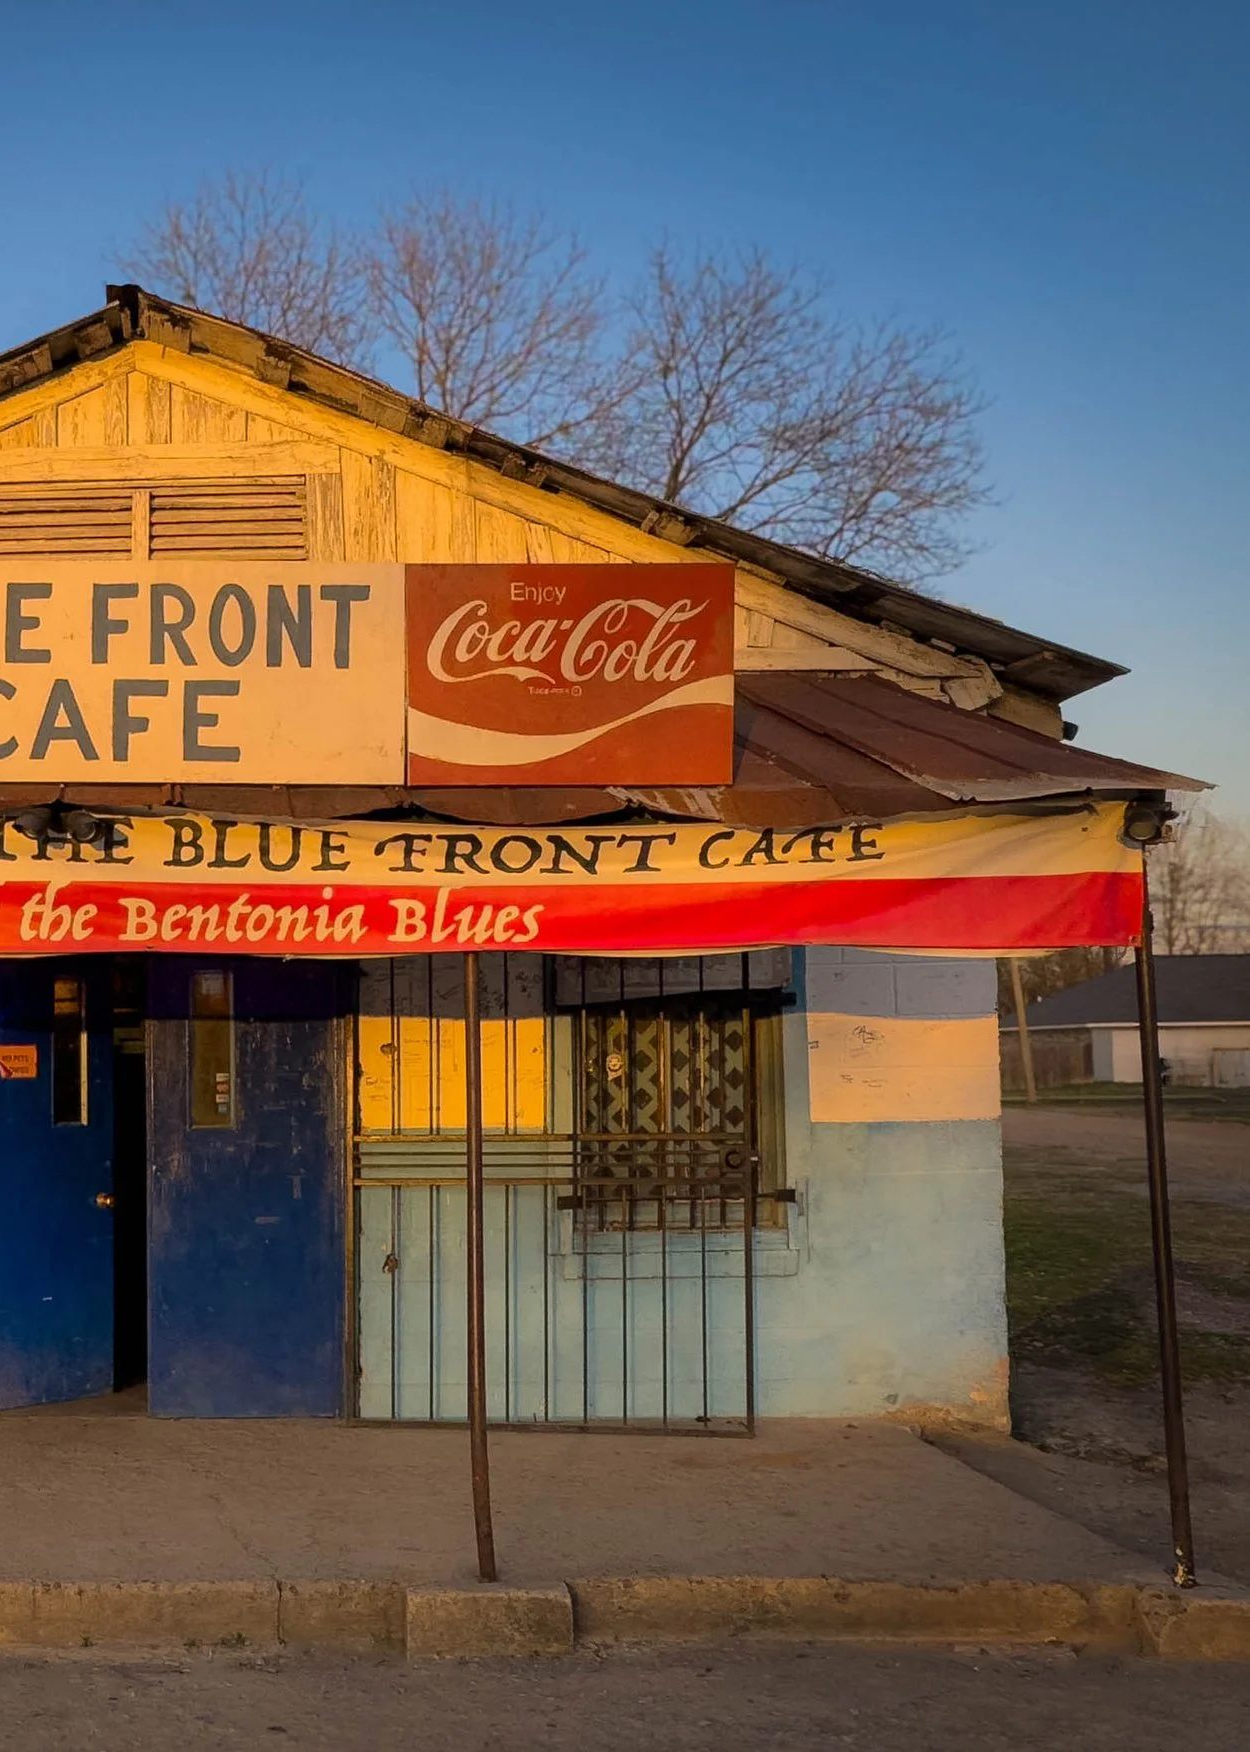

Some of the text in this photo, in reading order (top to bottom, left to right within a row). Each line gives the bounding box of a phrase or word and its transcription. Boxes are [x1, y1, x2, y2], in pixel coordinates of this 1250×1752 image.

[510, 581, 566, 605] Enjoy
[91, 582, 371, 669] FRONT
[426, 598, 711, 685] Coca-Cola
[163, 818, 350, 872] BLUE
[374, 831, 677, 875] FRONT
[699, 823, 886, 869] CAFE
[19, 880, 98, 942] the
[117, 886, 368, 944] Bentonia
[387, 885, 546, 944] Blues
